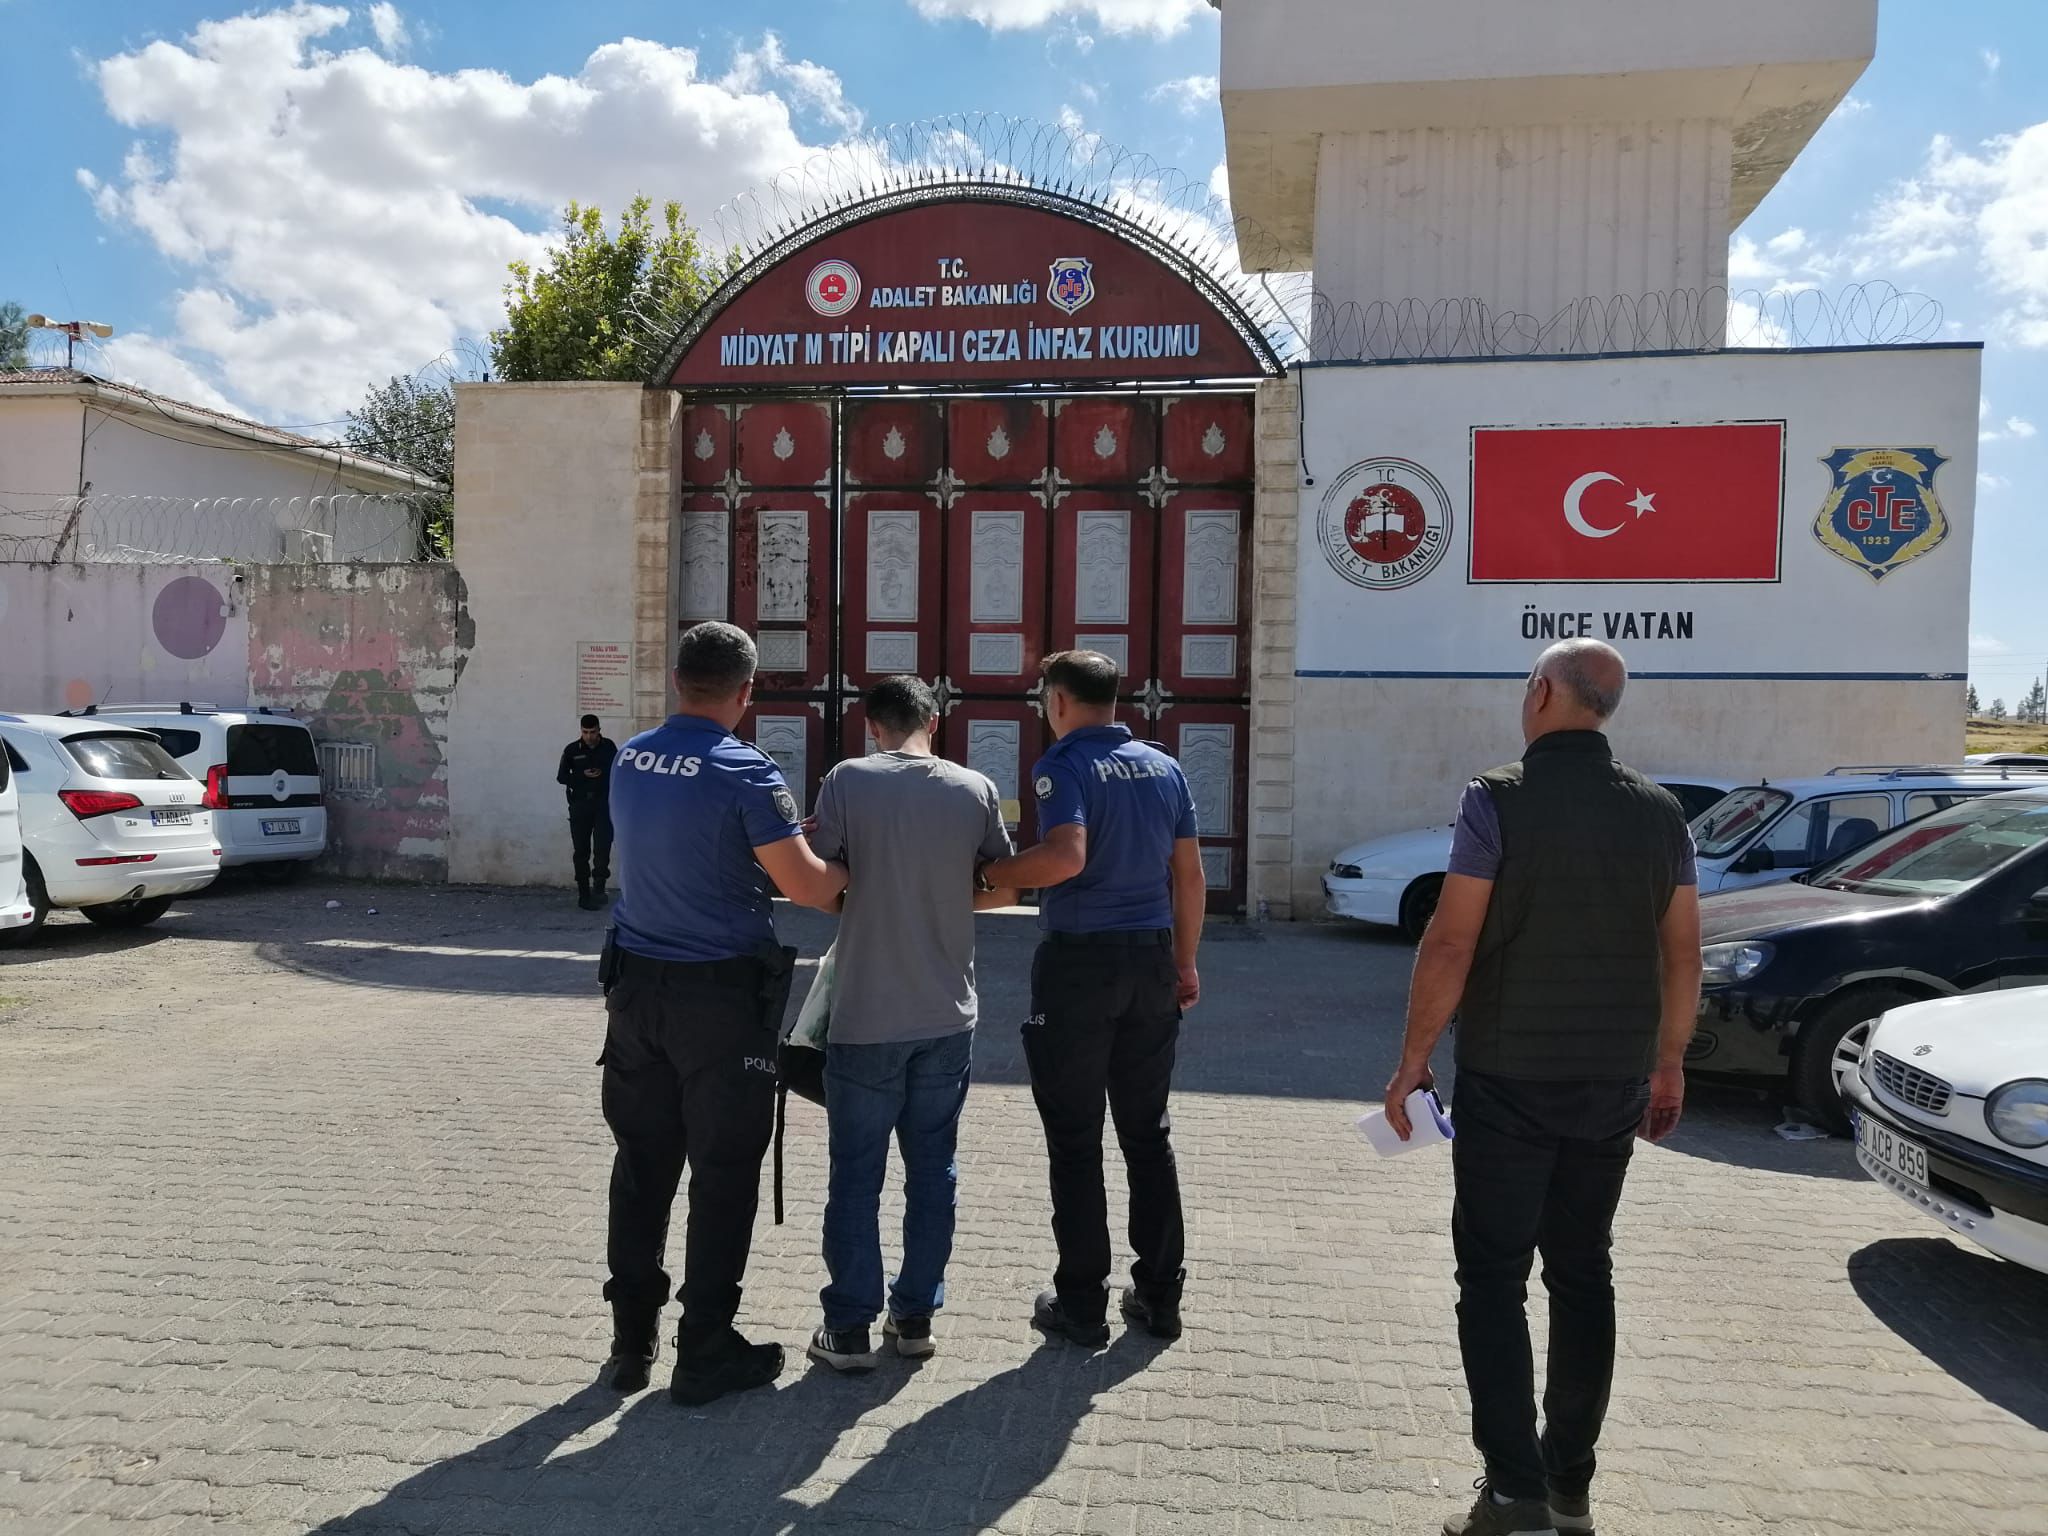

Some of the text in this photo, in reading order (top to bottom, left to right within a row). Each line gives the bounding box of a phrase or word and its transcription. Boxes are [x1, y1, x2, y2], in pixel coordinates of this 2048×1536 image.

[938, 258, 968, 279] T.C.
[870, 286, 936, 308] ADALET
[941, 279, 1037, 307] BAKANLIĞI
[1059, 279, 1082, 297] CTE
[721, 321, 1200, 366] MİDYAT M TİPİ KAPALI CEZA İNFAZ KURUMU
[1848, 486, 1916, 531] CTE
[1863, 536, 1890, 545] 1923
[1522, 605, 1693, 639] ÖNCE VATAN
[1872, 1127, 1893, 1163] ACB
[1899, 1142, 1925, 1181] 859
